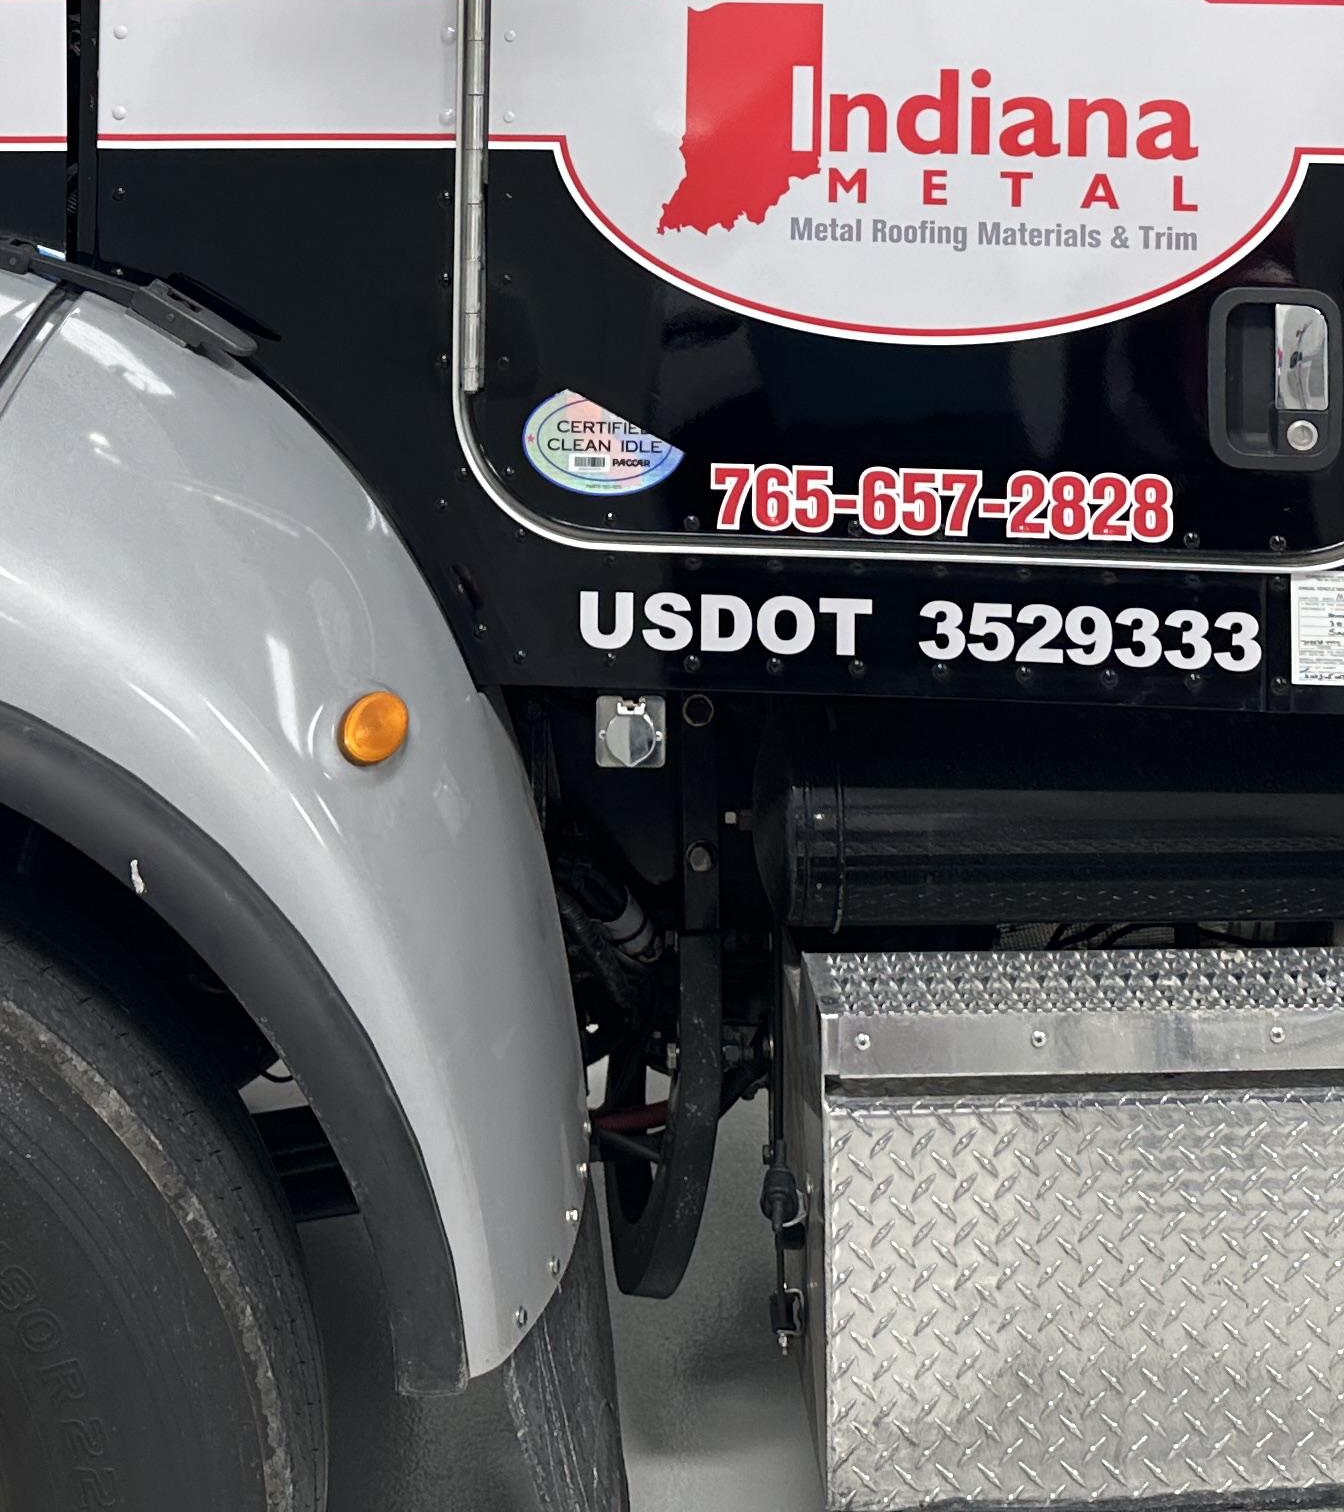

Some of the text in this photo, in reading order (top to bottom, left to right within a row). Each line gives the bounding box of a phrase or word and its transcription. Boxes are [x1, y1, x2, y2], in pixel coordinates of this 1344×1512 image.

[790, 65, 1199, 160] Indiana
[828, 167, 1198, 212] METAL
[790, 216, 1198, 252] Metal Roofing Materials & Trim
[547, 438, 663, 454] CLEAN IDLE
[612, 458, 650, 467] PACCAR
[711, 463, 1173, 542] 765-657-2828
[579, 591, 1262, 673] USDOT 3529333
